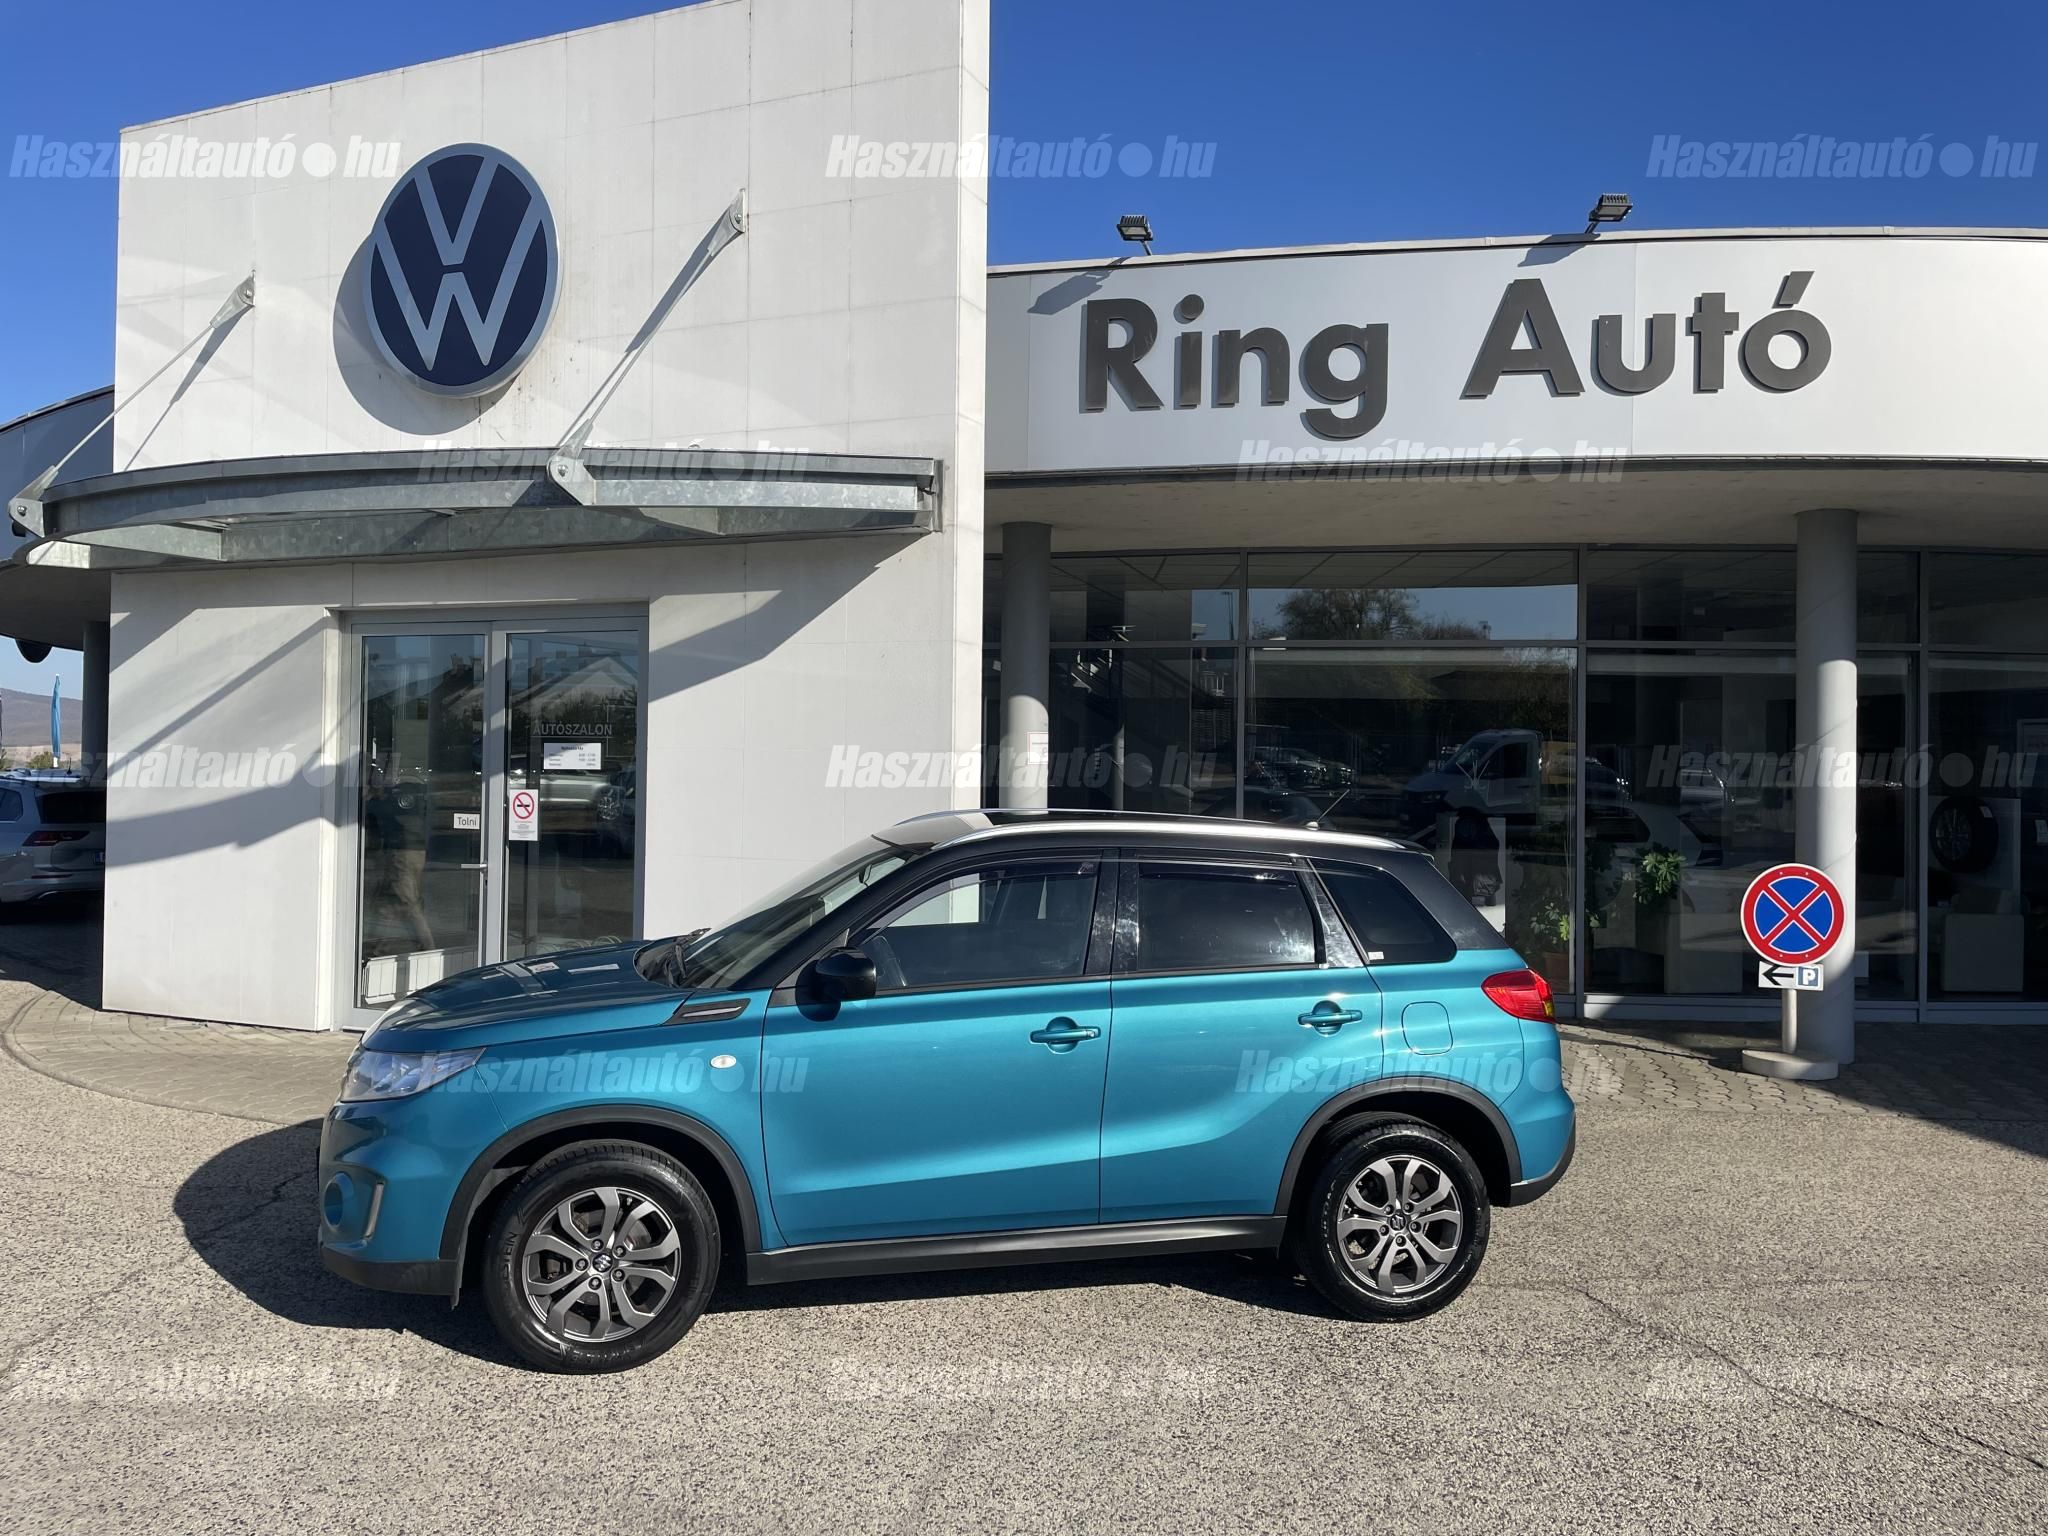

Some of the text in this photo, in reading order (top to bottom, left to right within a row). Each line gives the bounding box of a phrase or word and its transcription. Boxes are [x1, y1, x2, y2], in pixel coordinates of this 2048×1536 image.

[1084, 271, 1832, 438] Ring Autó
[532, 720, 612, 735] AUTÓSZALON
[457, 816, 477, 827] Tolni
[1803, 969, 1816, 985] P
